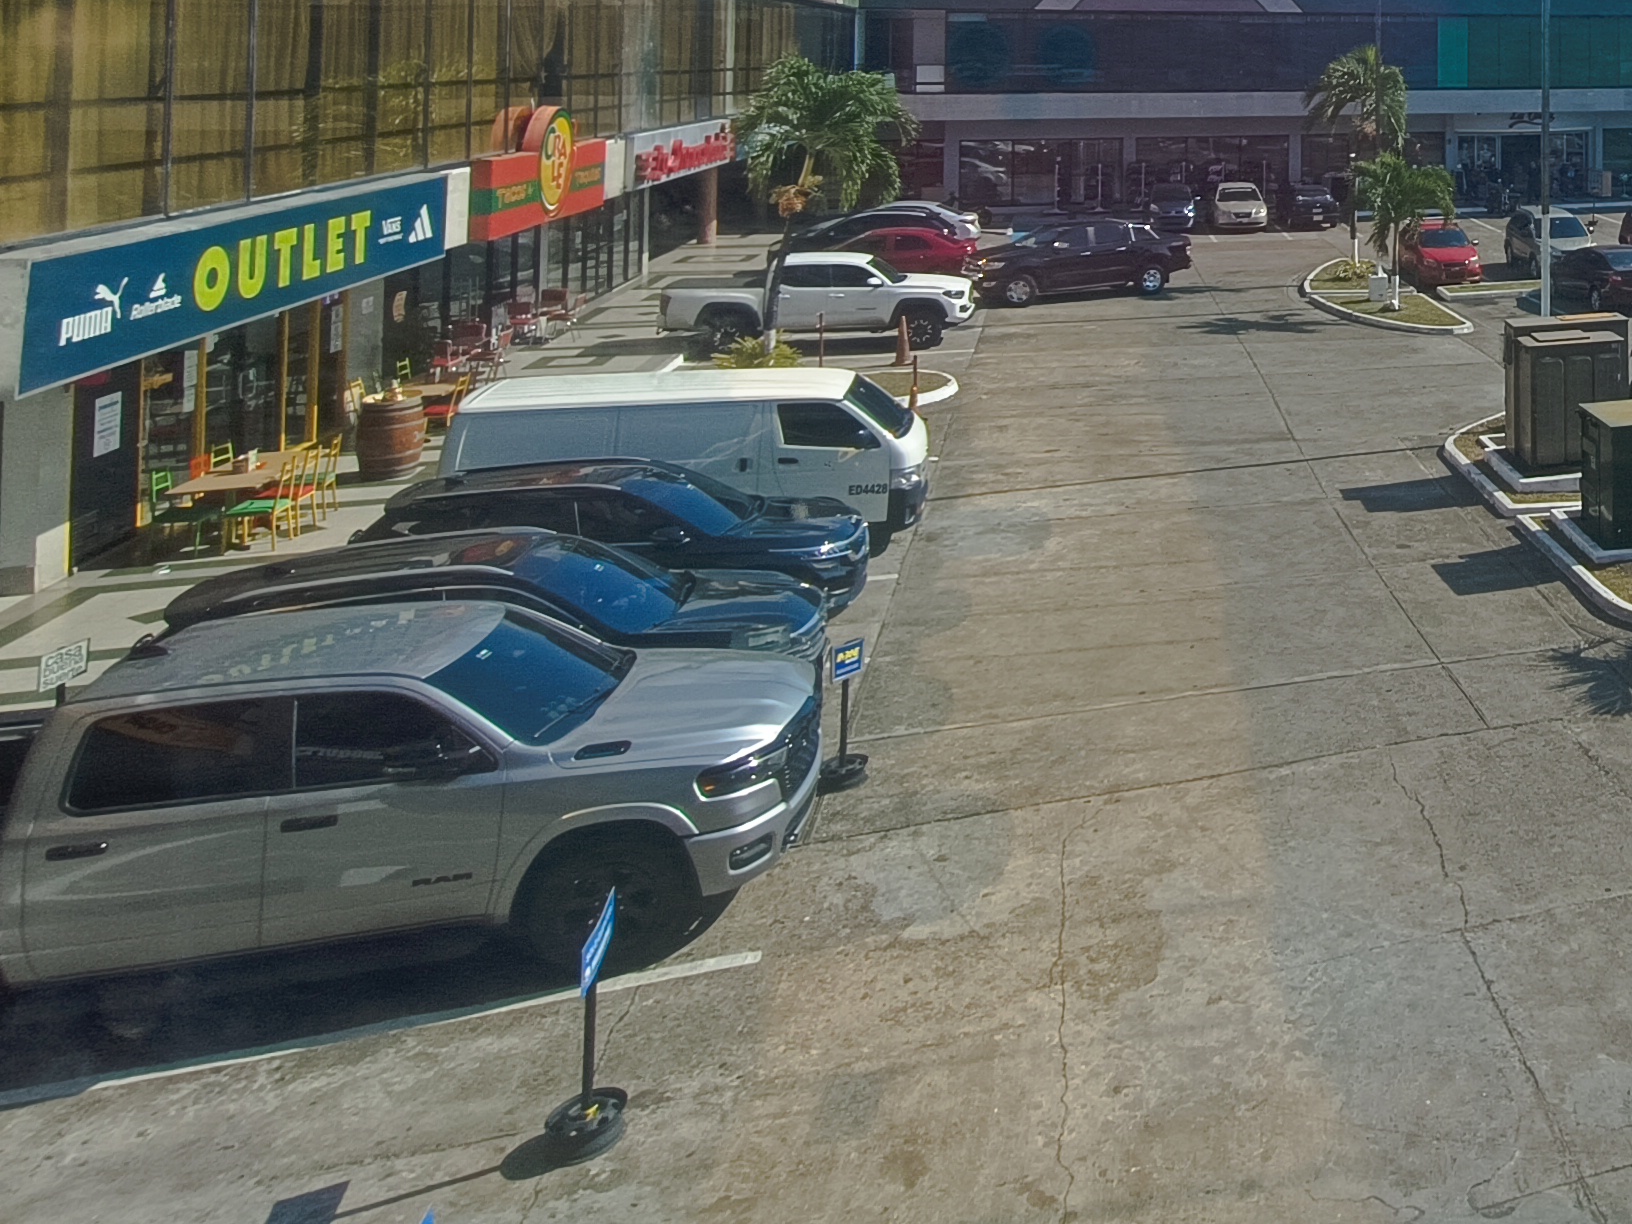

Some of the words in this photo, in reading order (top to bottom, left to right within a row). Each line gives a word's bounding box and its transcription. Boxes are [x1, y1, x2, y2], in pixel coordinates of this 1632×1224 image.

[193, 210, 371, 311] OUTLET
[58, 307, 112, 346] PUMA
[848, 483, 888, 496] ED4428
[45, 644, 83, 668] casa
[411, 871, 473, 888] RAM
